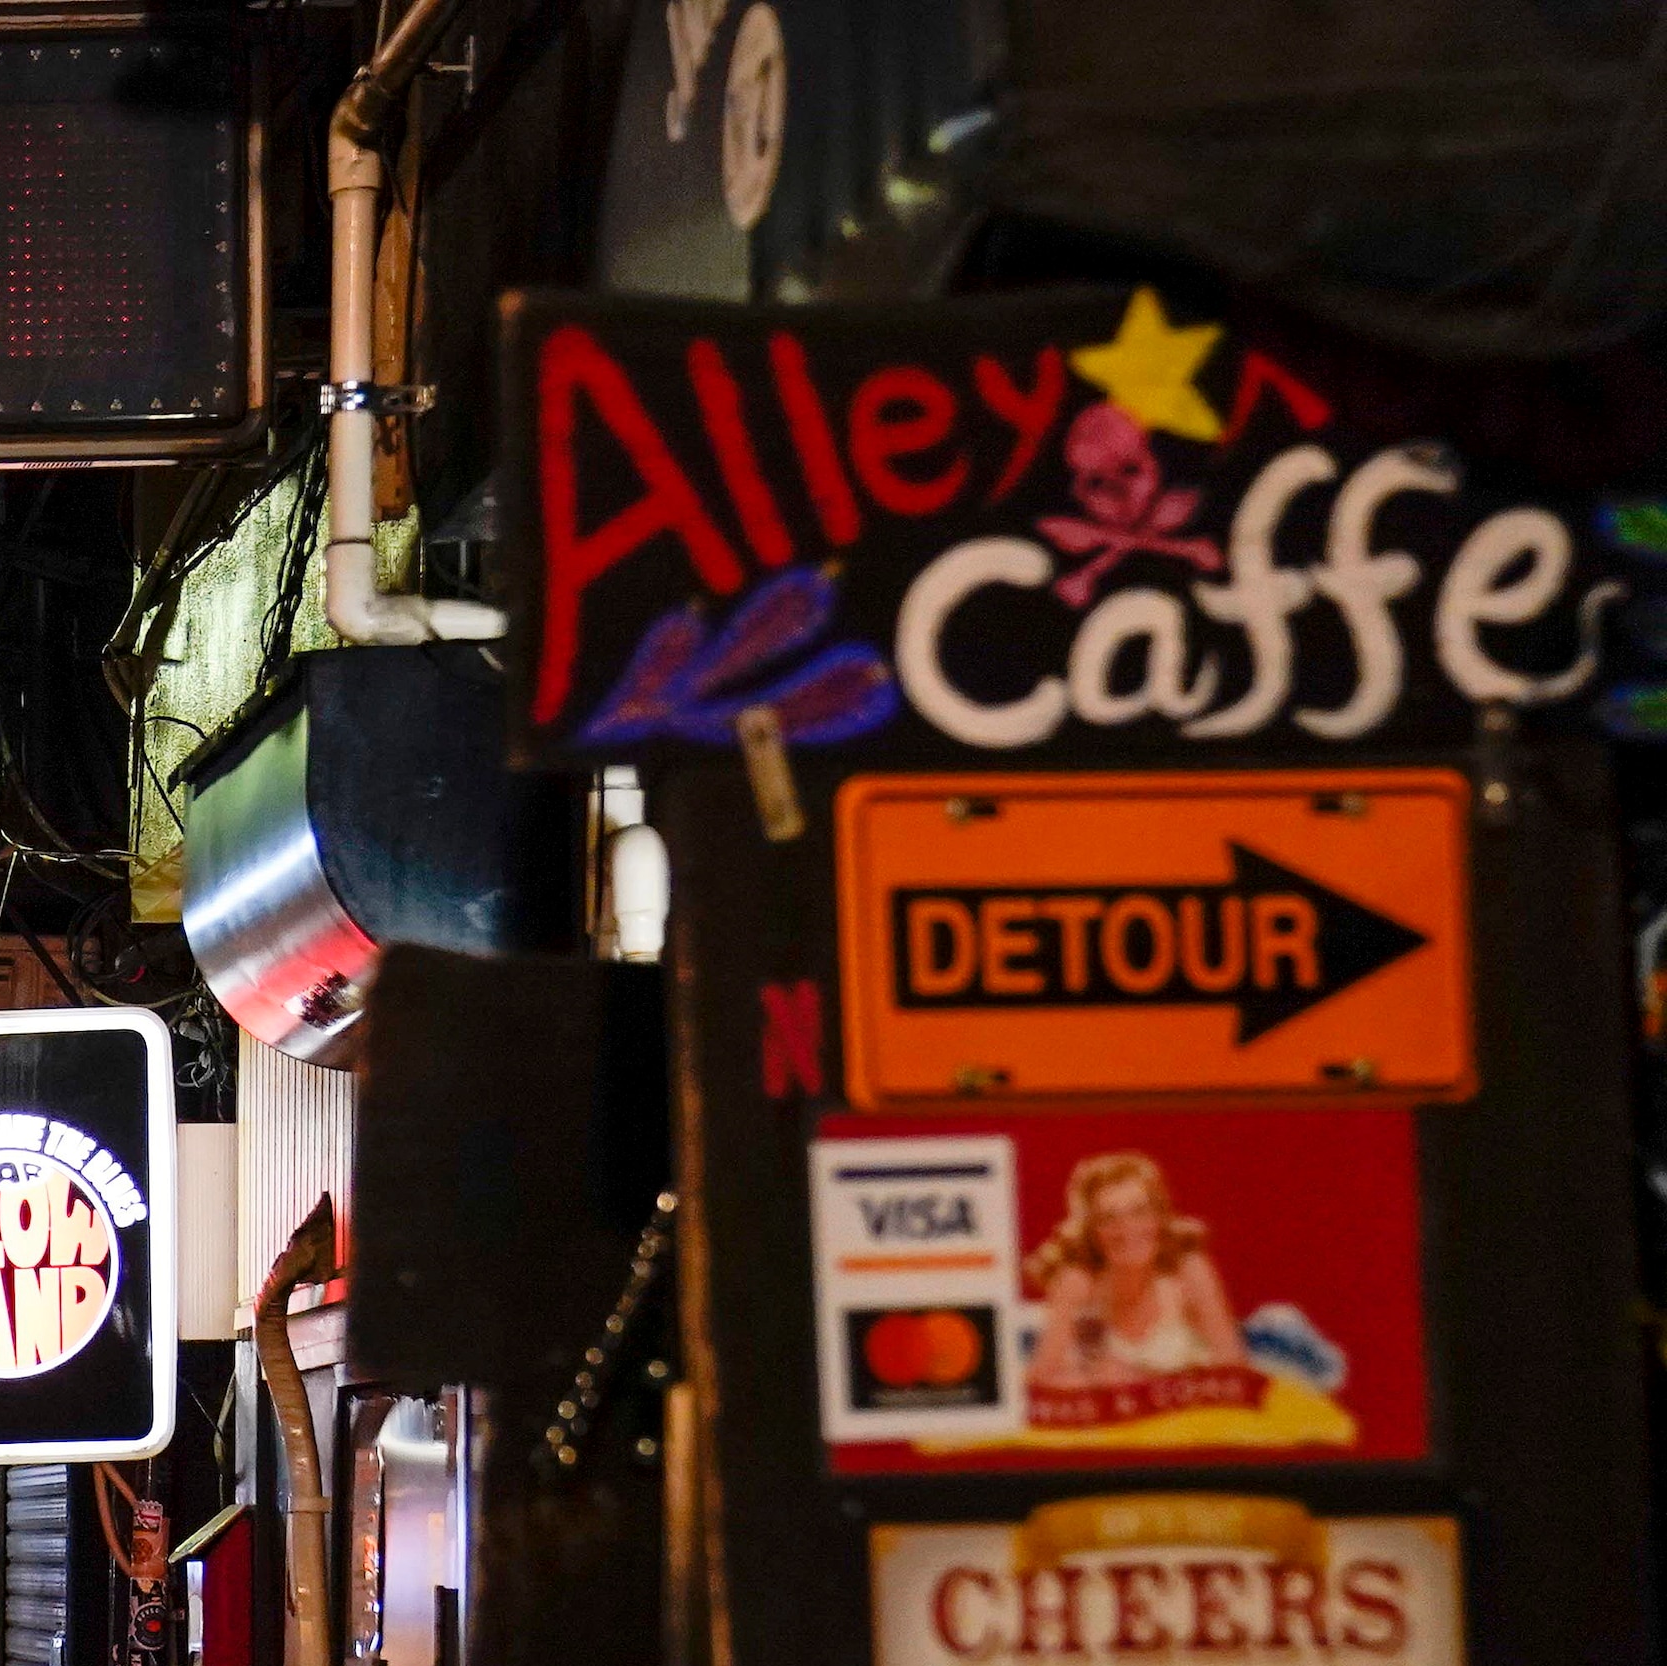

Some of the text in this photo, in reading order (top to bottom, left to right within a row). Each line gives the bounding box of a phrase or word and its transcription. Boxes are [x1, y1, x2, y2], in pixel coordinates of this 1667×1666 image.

[533, 325, 1064, 722] Alley
[895, 445, 1627, 750] Caffe
[906, 893, 1320, 997] DETOUR
[43, 1120, 98, 1172] THE
[80, 1149, 148, 1229] BLUES
[857, 1195, 979, 1240] VISA
[931, 1562, 1409, 1659] CHEERS
